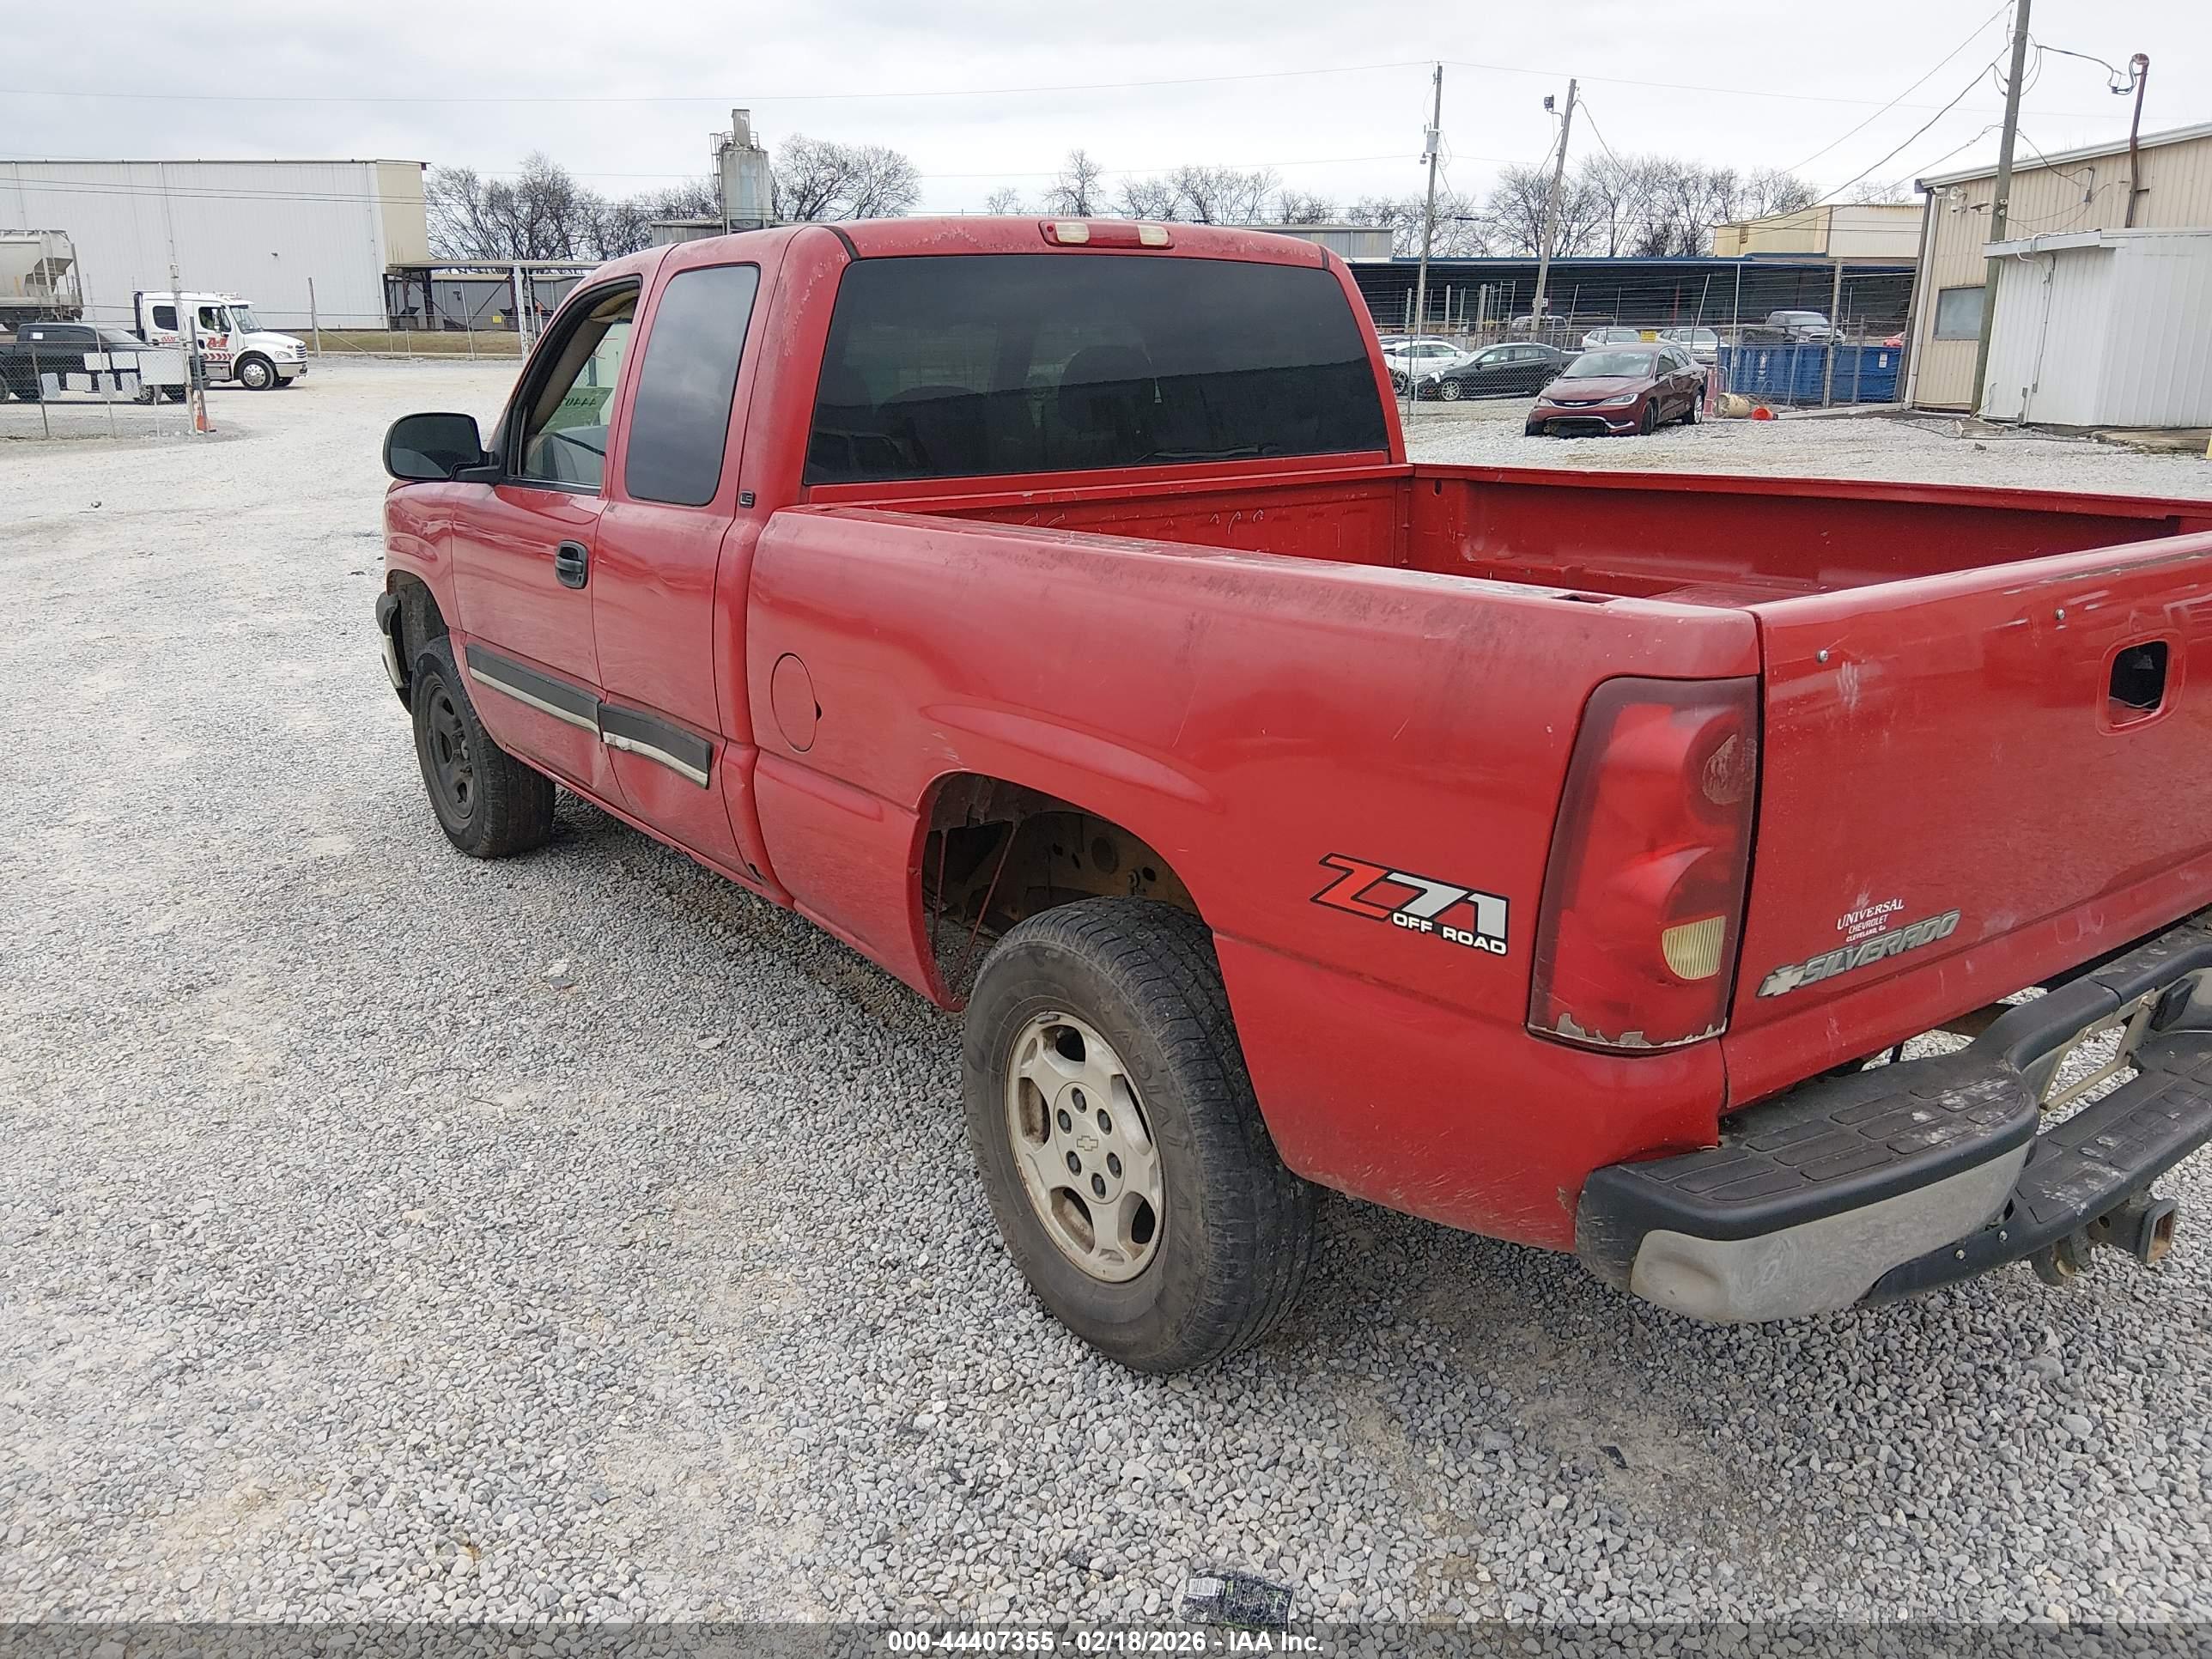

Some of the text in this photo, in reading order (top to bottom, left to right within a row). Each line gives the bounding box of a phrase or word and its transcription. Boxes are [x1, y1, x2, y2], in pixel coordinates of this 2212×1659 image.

[1310, 852, 1510, 940] Z71
[1837, 898, 1905, 931] UNIVERSAL
[1392, 911, 1508, 956] OFF ROAD
[1848, 914, 1889, 934] CHEVROLET
[1800, 909, 1961, 986] SILVERADO
